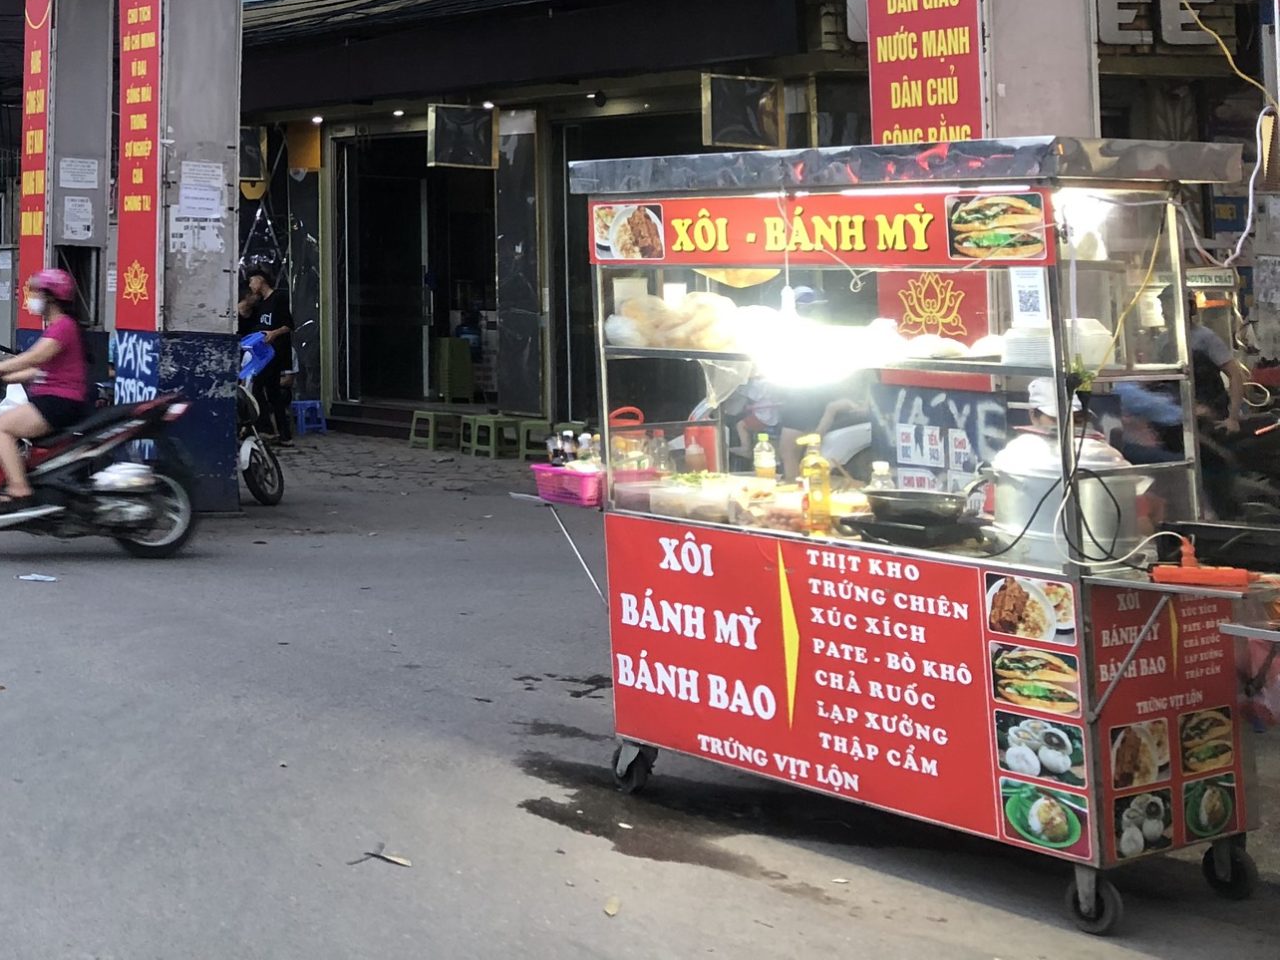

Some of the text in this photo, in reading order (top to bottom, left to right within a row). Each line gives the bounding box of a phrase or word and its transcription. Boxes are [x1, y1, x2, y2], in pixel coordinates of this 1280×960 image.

[876, 25, 970, 63] NƯỚC MẠNH
[890, 65, 959, 109] DÂN CHỦ
[671, 208, 729, 253] XÔI
[764, 206, 867, 253] BÁNH
[875, 203, 934, 252] MỲ
[658, 531, 714, 577] XÔI
[806, 549, 920, 581] THỊT KHO
[620, 588, 761, 651] BÁNH MỲ
[808, 578, 968, 620] TRỨNG CHIÊN
[810, 606, 926, 643] XÚC XÍCH
[812, 638, 868, 664] PATE
[886, 651, 916, 673] BÒ
[922, 659, 972, 685] KHÔ
[1140, 656, 1167, 677] BAO
[616, 649, 776, 721] BÁNH BAO
[815, 670, 936, 710] CHẢ RUỐC
[816, 701, 948, 746] LẠP XƯỞNG
[696, 734, 859, 792] TRỨNG VỊT LỘN
[818, 731, 938, 777] THẬP CẨM
